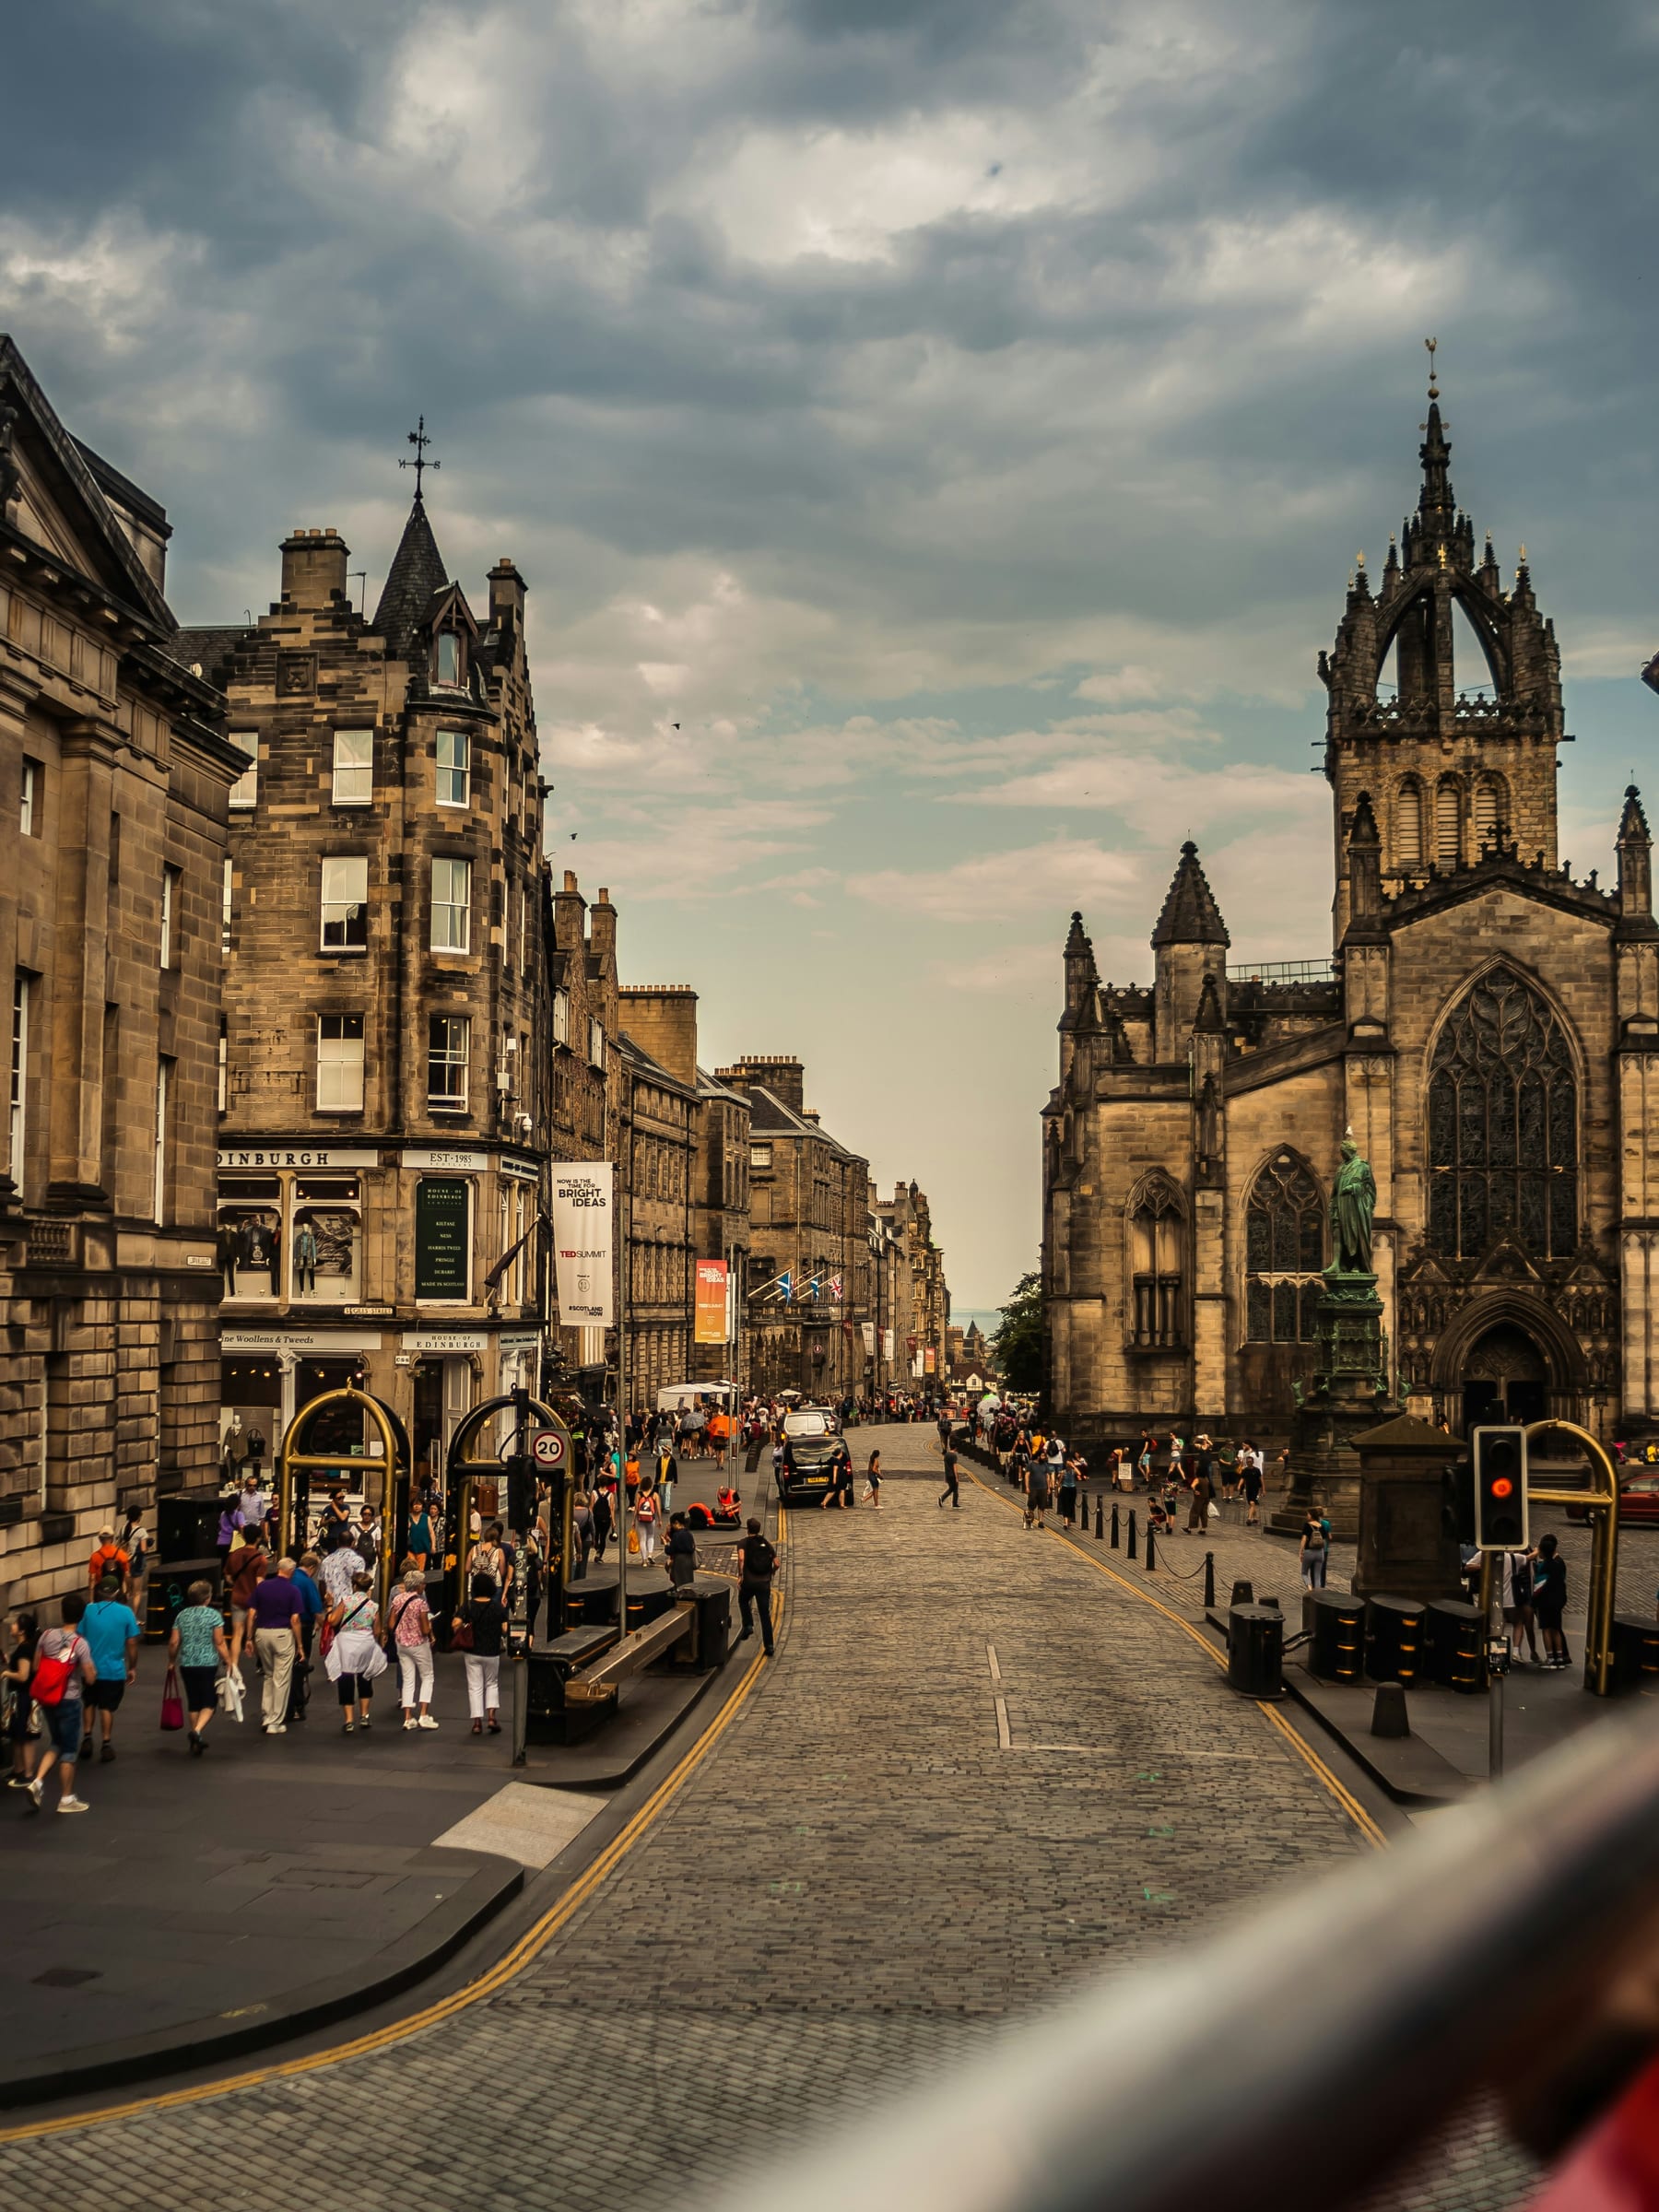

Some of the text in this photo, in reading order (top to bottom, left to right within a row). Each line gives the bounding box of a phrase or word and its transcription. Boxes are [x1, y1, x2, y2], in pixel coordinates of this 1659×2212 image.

[559, 1189, 602, 1198] BRIGHT
[572, 1198, 606, 1207] IDEAS
[236, 1335, 274, 1343] Woollens
[275, 1335, 282, 1344] &
[283, 1335, 314, 1344] Tweeds
[537, 1441, 560, 1455] 20
